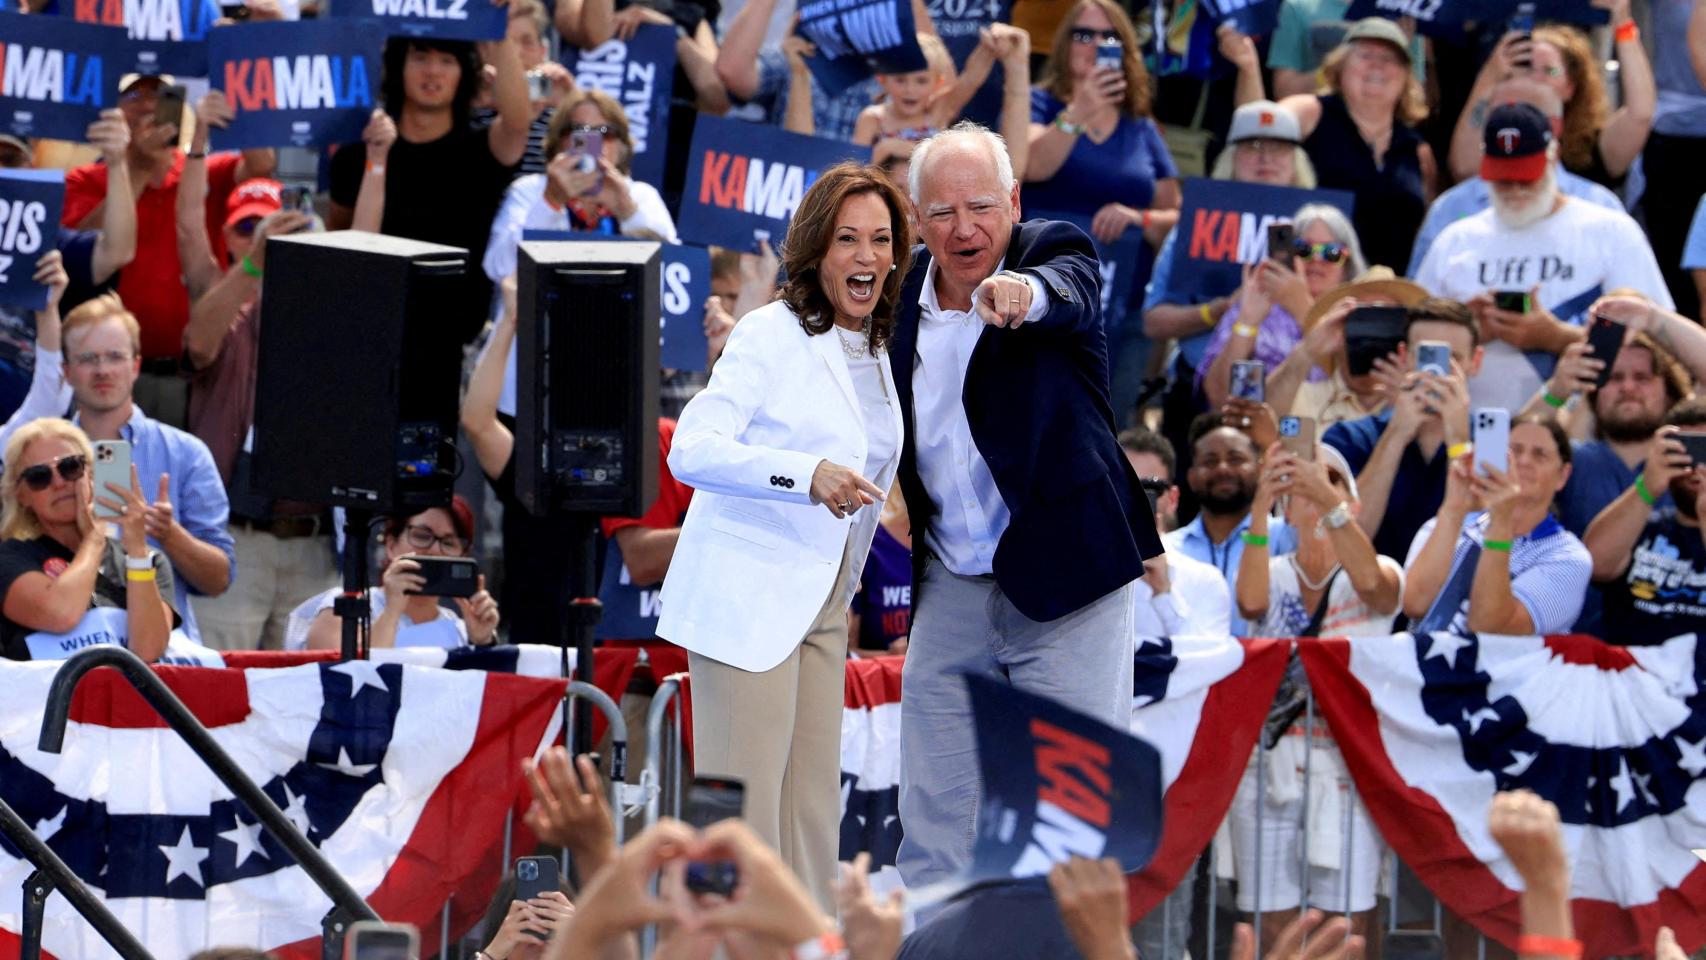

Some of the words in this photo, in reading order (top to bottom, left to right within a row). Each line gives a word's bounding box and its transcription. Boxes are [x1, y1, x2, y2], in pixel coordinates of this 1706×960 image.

[371, 0, 468, 20] WALZ
[0, 42, 103, 107] MALA
[224, 55, 371, 111] KAMALA
[1190, 208, 1293, 266] KAM
[1478, 256, 1530, 287] Uff
[1539, 253, 1574, 283] Da
